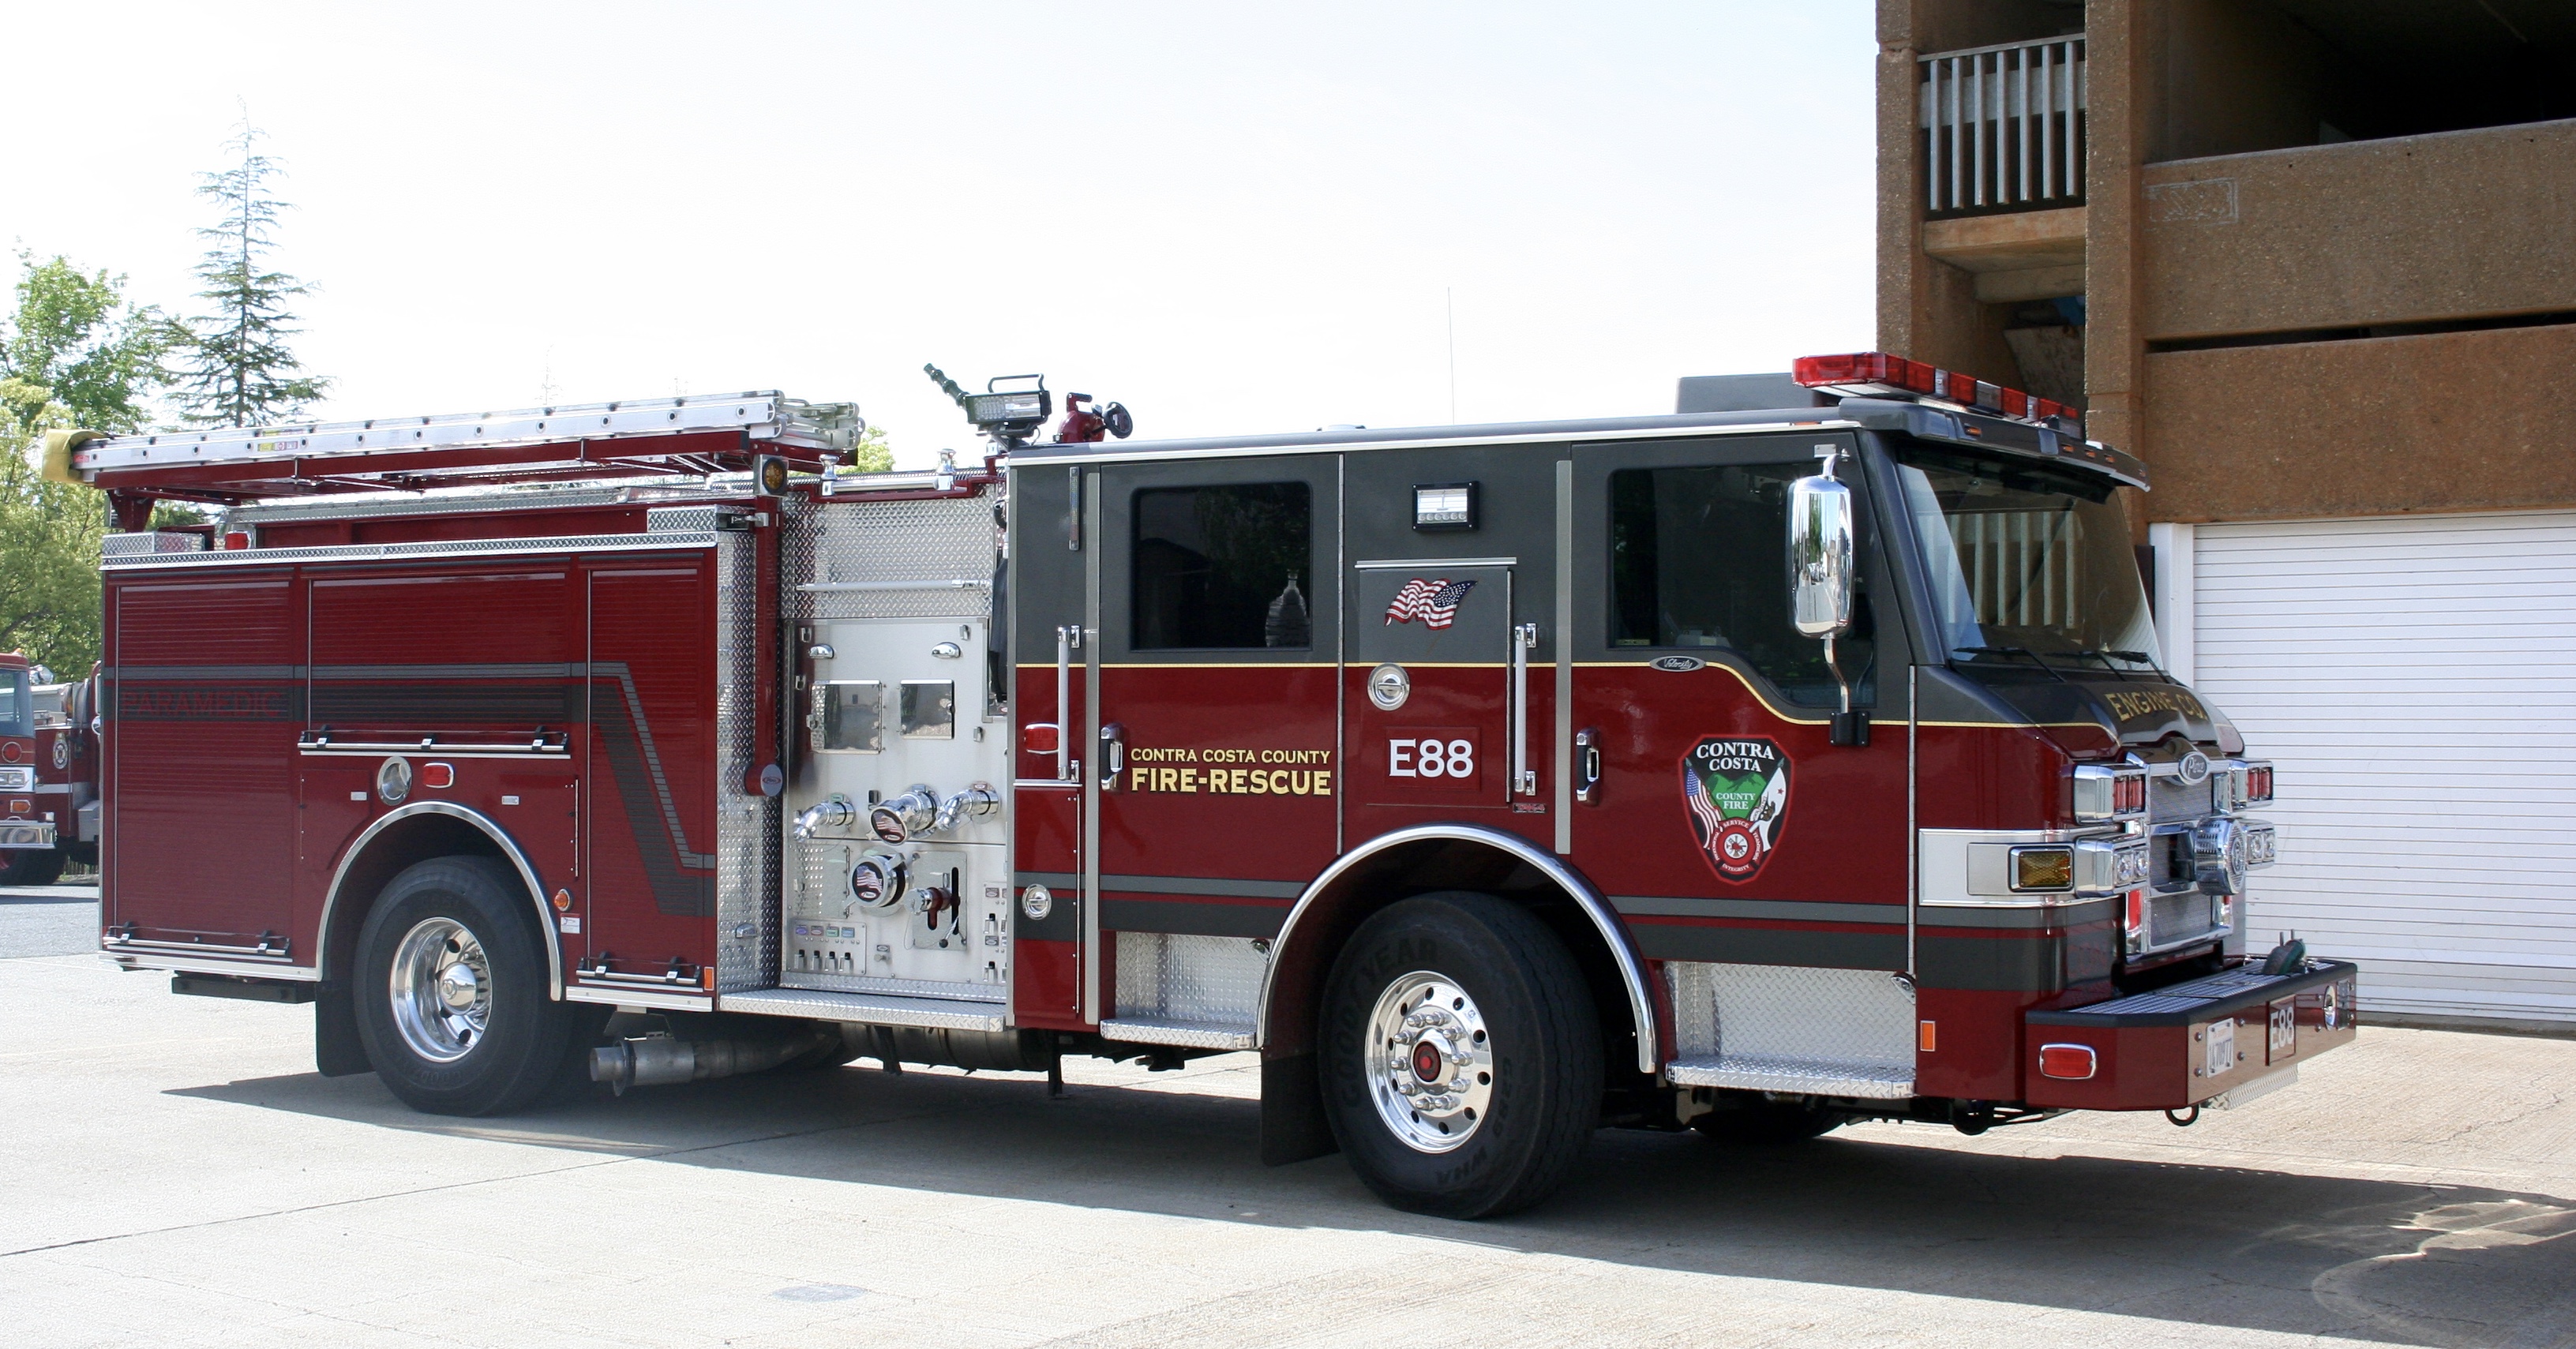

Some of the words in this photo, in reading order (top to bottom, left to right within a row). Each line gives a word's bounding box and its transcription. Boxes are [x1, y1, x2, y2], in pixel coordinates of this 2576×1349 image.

[122, 691, 283, 716] PARAMEDIC
[2104, 691, 2179, 721] ENGINE
[1131, 748, 1198, 763] CONTRA
[1202, 748, 1256, 763] COSTA
[1262, 749, 1331, 765] COUNTY
[1389, 738, 1474, 778] E88
[1696, 742, 1775, 761] CONTRA
[1708, 757, 1762, 773] COSTA
[1131, 767, 1332, 796] FIRE-RESCUE
[1715, 792, 1756, 800] COUNTY
[1723, 800, 1749, 810] FIRE
[1723, 819, 1749, 829] SERVICE
[2270, 1006, 2294, 1051] E88
